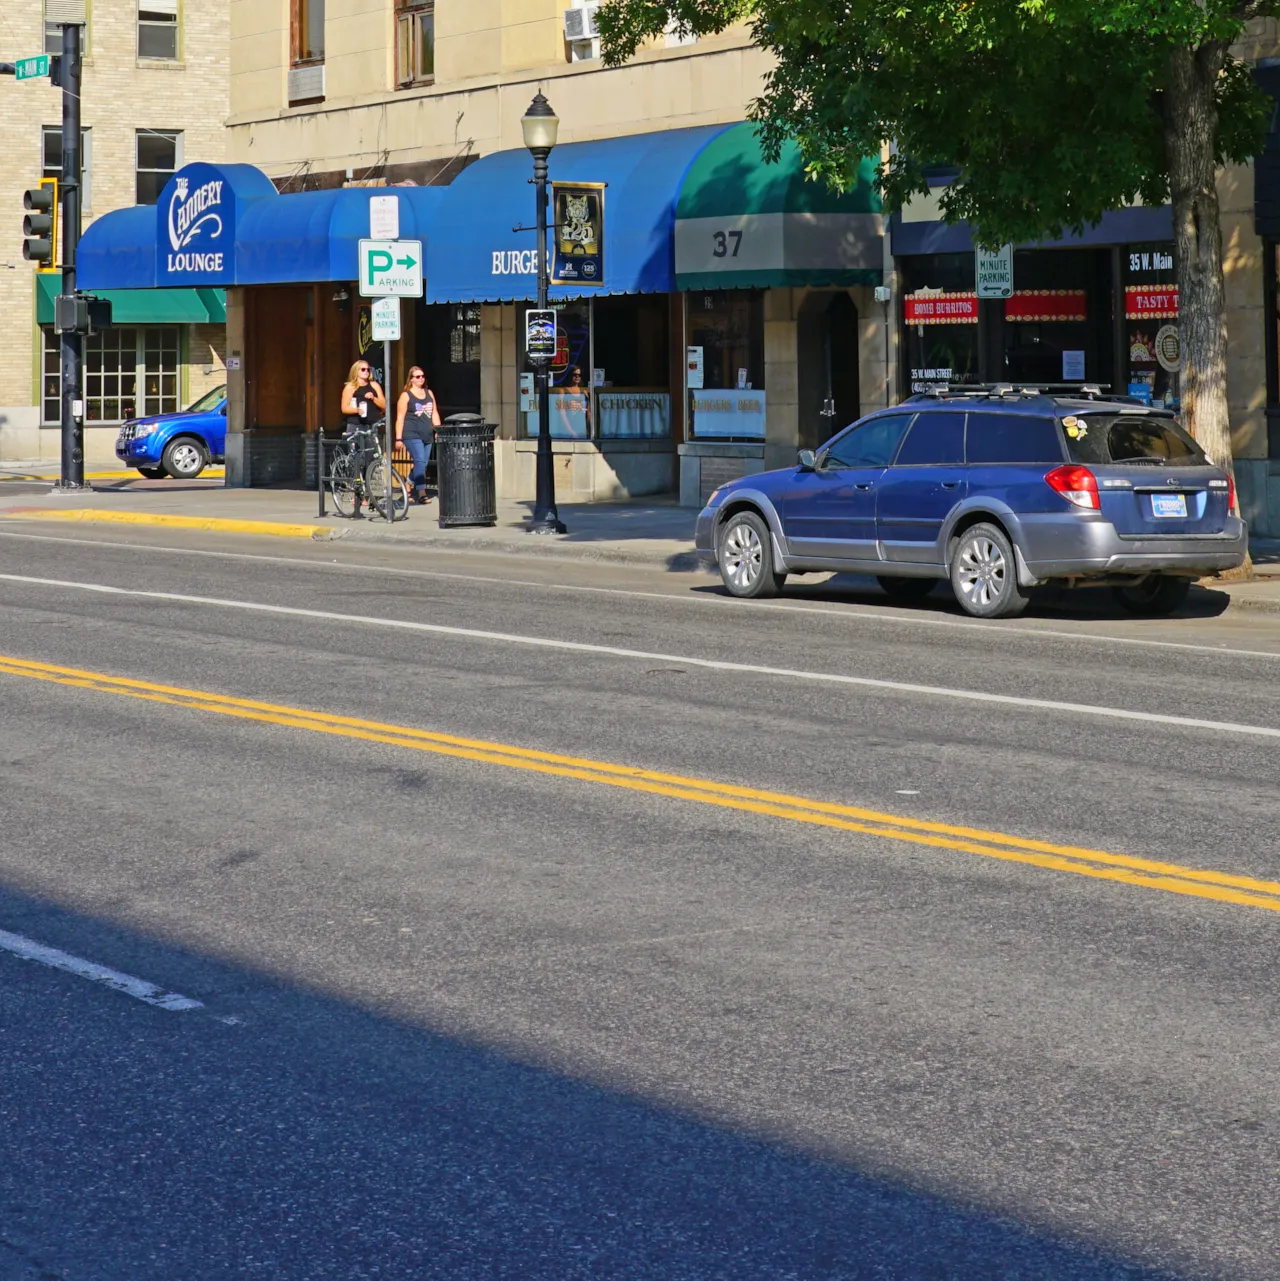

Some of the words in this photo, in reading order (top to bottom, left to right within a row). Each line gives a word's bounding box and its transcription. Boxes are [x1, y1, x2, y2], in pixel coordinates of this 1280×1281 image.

[24, 59, 37, 77] MAIN
[175, 177, 189, 190] THE
[712, 230, 743, 257] 37
[167, 252, 224, 272] LOUNGE
[980, 259, 1008, 271] MINUTE
[1129, 253, 1140, 271] 35
[1141, 254, 1152, 270] W.
[1153, 252, 1173, 270] Main
[979, 272, 1010, 283] PARKING
[914, 303, 934, 315] BOMB
[936, 302, 972, 314] BURRITOS
[1136, 295, 1169, 309] TASTY
[375, 310, 396, 319] MINUTE
[374, 320, 398, 329] PARKING
[600, 398, 663, 410] CHICKEN
[691, 399, 732, 411] BURGERS
[738, 399, 761, 411] BEER
